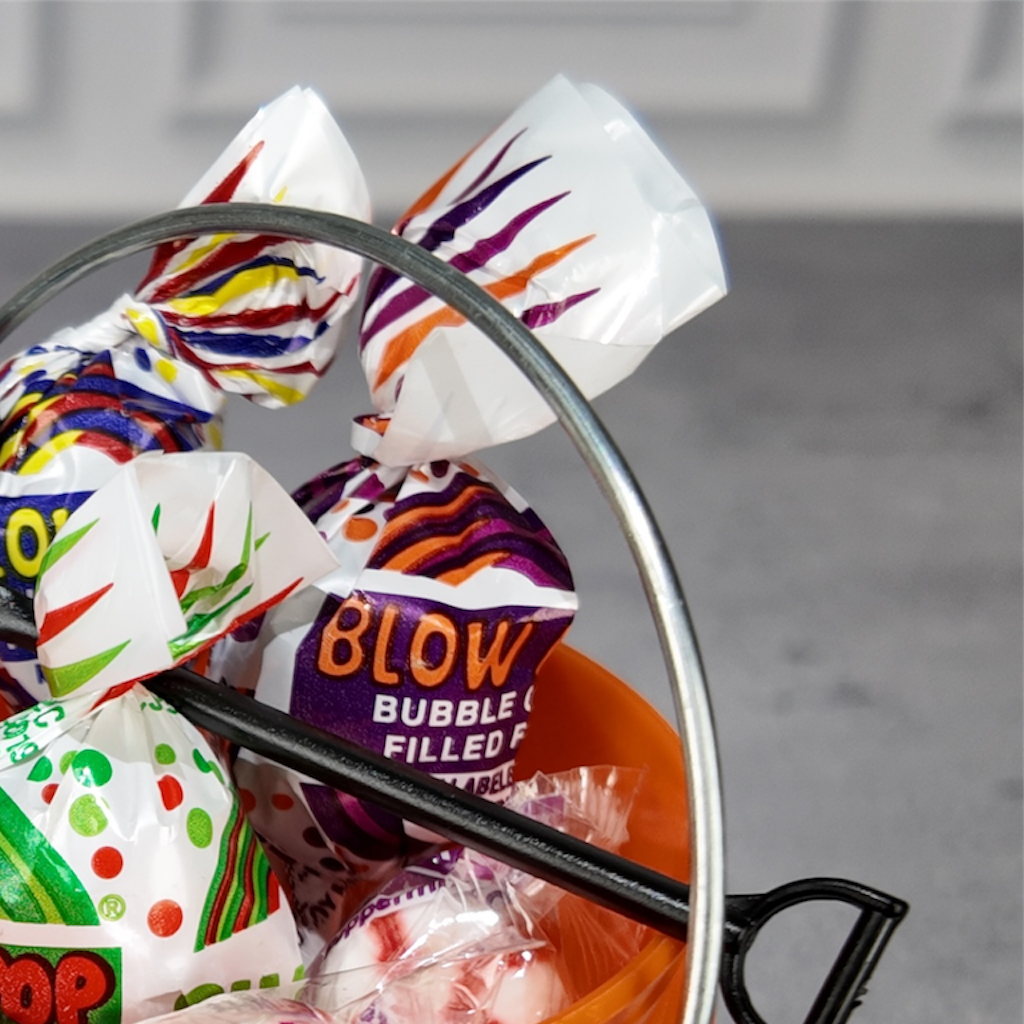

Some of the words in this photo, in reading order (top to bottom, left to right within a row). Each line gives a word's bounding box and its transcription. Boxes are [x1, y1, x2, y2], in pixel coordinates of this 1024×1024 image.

[318, 594, 535, 690] BLOW
[372, 691, 518, 728] BUBBLE
[383, 733, 504, 764] FILLED
